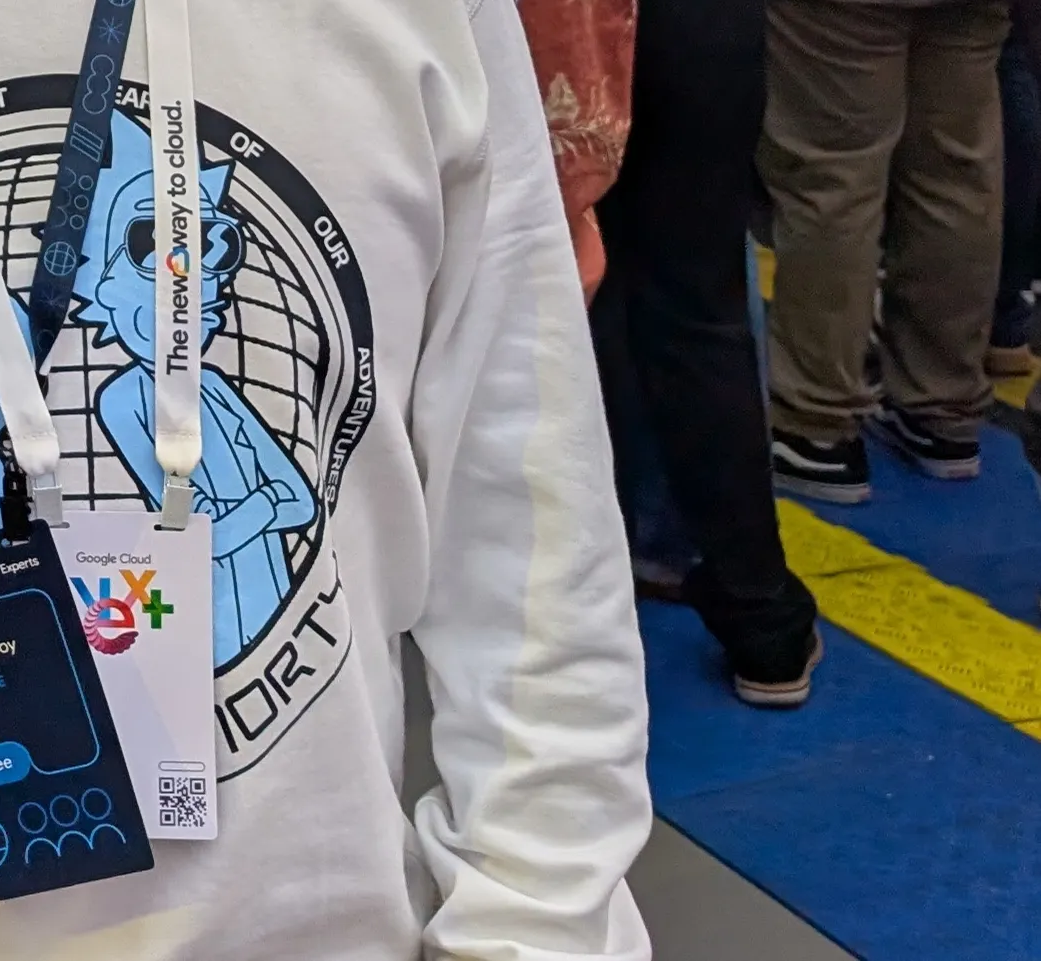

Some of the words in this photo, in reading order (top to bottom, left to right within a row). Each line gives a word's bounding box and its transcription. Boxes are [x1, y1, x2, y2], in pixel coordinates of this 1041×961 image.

[160, 99, 185, 169] cloud.
[229, 131, 265, 158] OF
[167, 172, 187, 197] to
[171, 201, 193, 249] way
[313, 215, 351, 270] OUR
[172, 271, 189, 324] new
[165, 329, 189, 375] The
[325, 346, 373, 504] ADVENTURES
[0, 556, 41, 575] Experts
[75, 551, 117, 566] Google
[119, 553, 152, 565] Cloud
